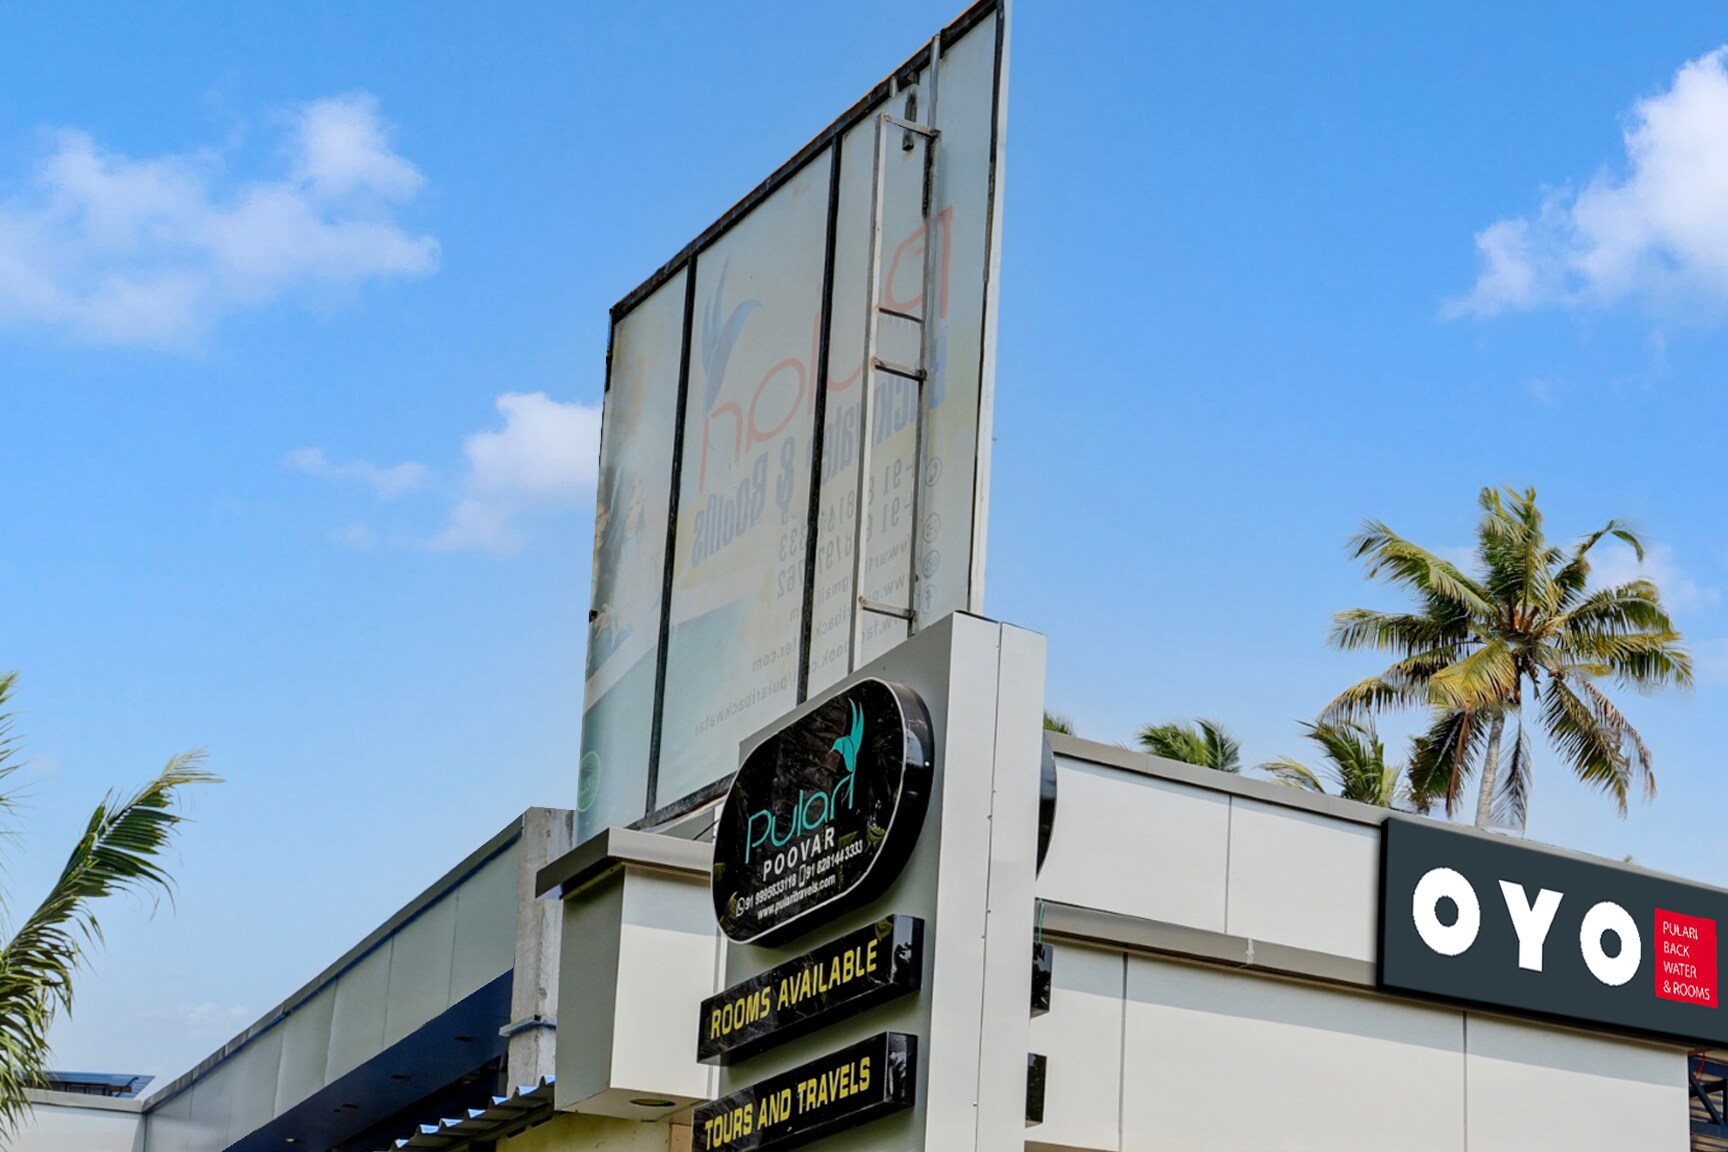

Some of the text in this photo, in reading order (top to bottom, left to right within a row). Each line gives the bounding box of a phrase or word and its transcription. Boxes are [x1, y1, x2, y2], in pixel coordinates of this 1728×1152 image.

[762, 826, 836, 882] POOVAR
[1412, 866, 1642, 987] OYO
[1662, 921, 1699, 941] PULARI
[1663, 941, 1691, 958] BACK
[1663, 960, 1698, 979] WATER
[710, 938, 879, 1040] ROOMS AVAILABLE
[1663, 980, 1711, 1001] & ROOMS
[705, 1055, 872, 1151] TOURS AND TRAVELS
